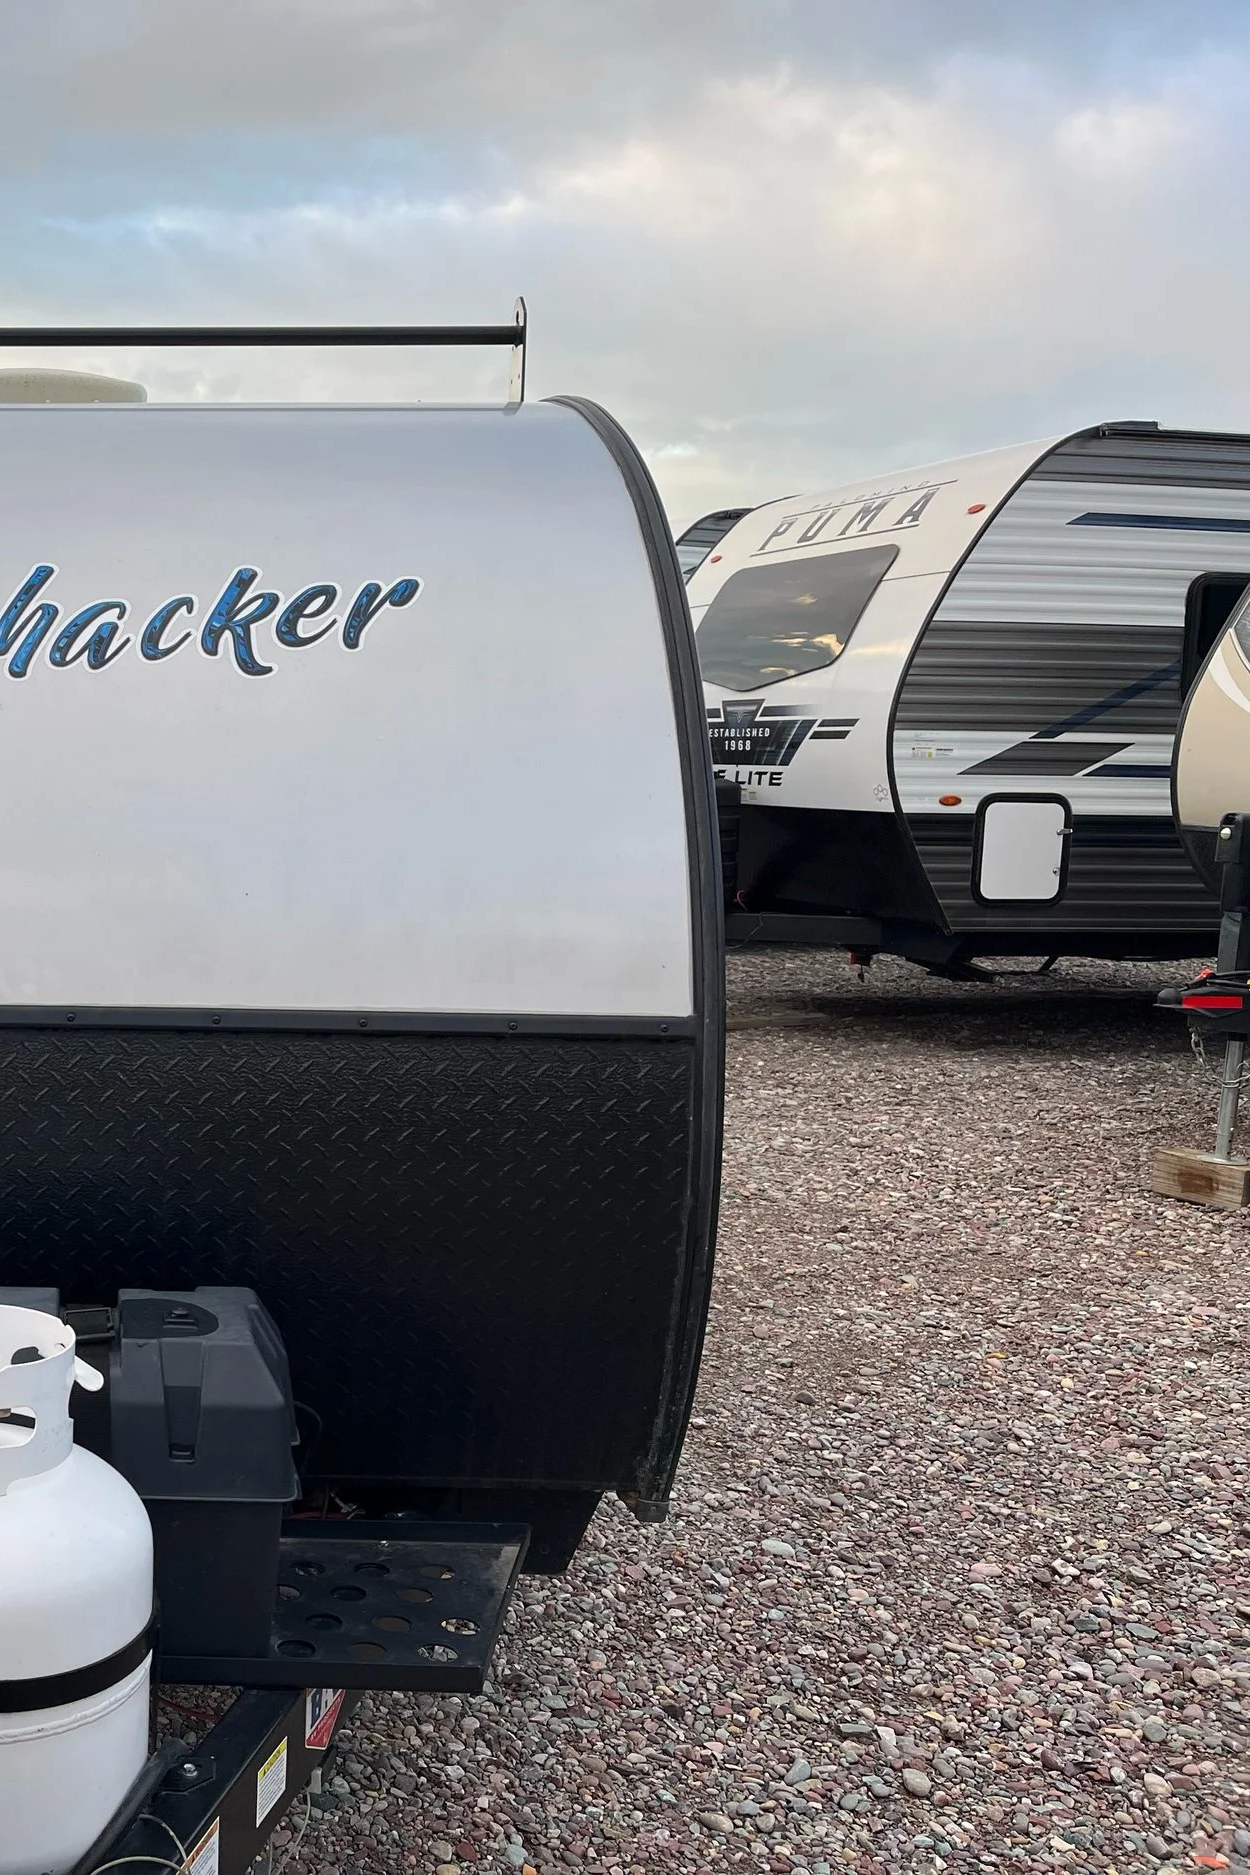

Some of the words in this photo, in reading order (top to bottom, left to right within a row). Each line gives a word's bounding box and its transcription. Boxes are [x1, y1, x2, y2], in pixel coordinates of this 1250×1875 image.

[757, 487, 941, 552] PUMA
[708, 727, 771, 738] ESTABLISHED
[724, 739, 751, 751] 1968
[734, 770, 785, 787] LITE
